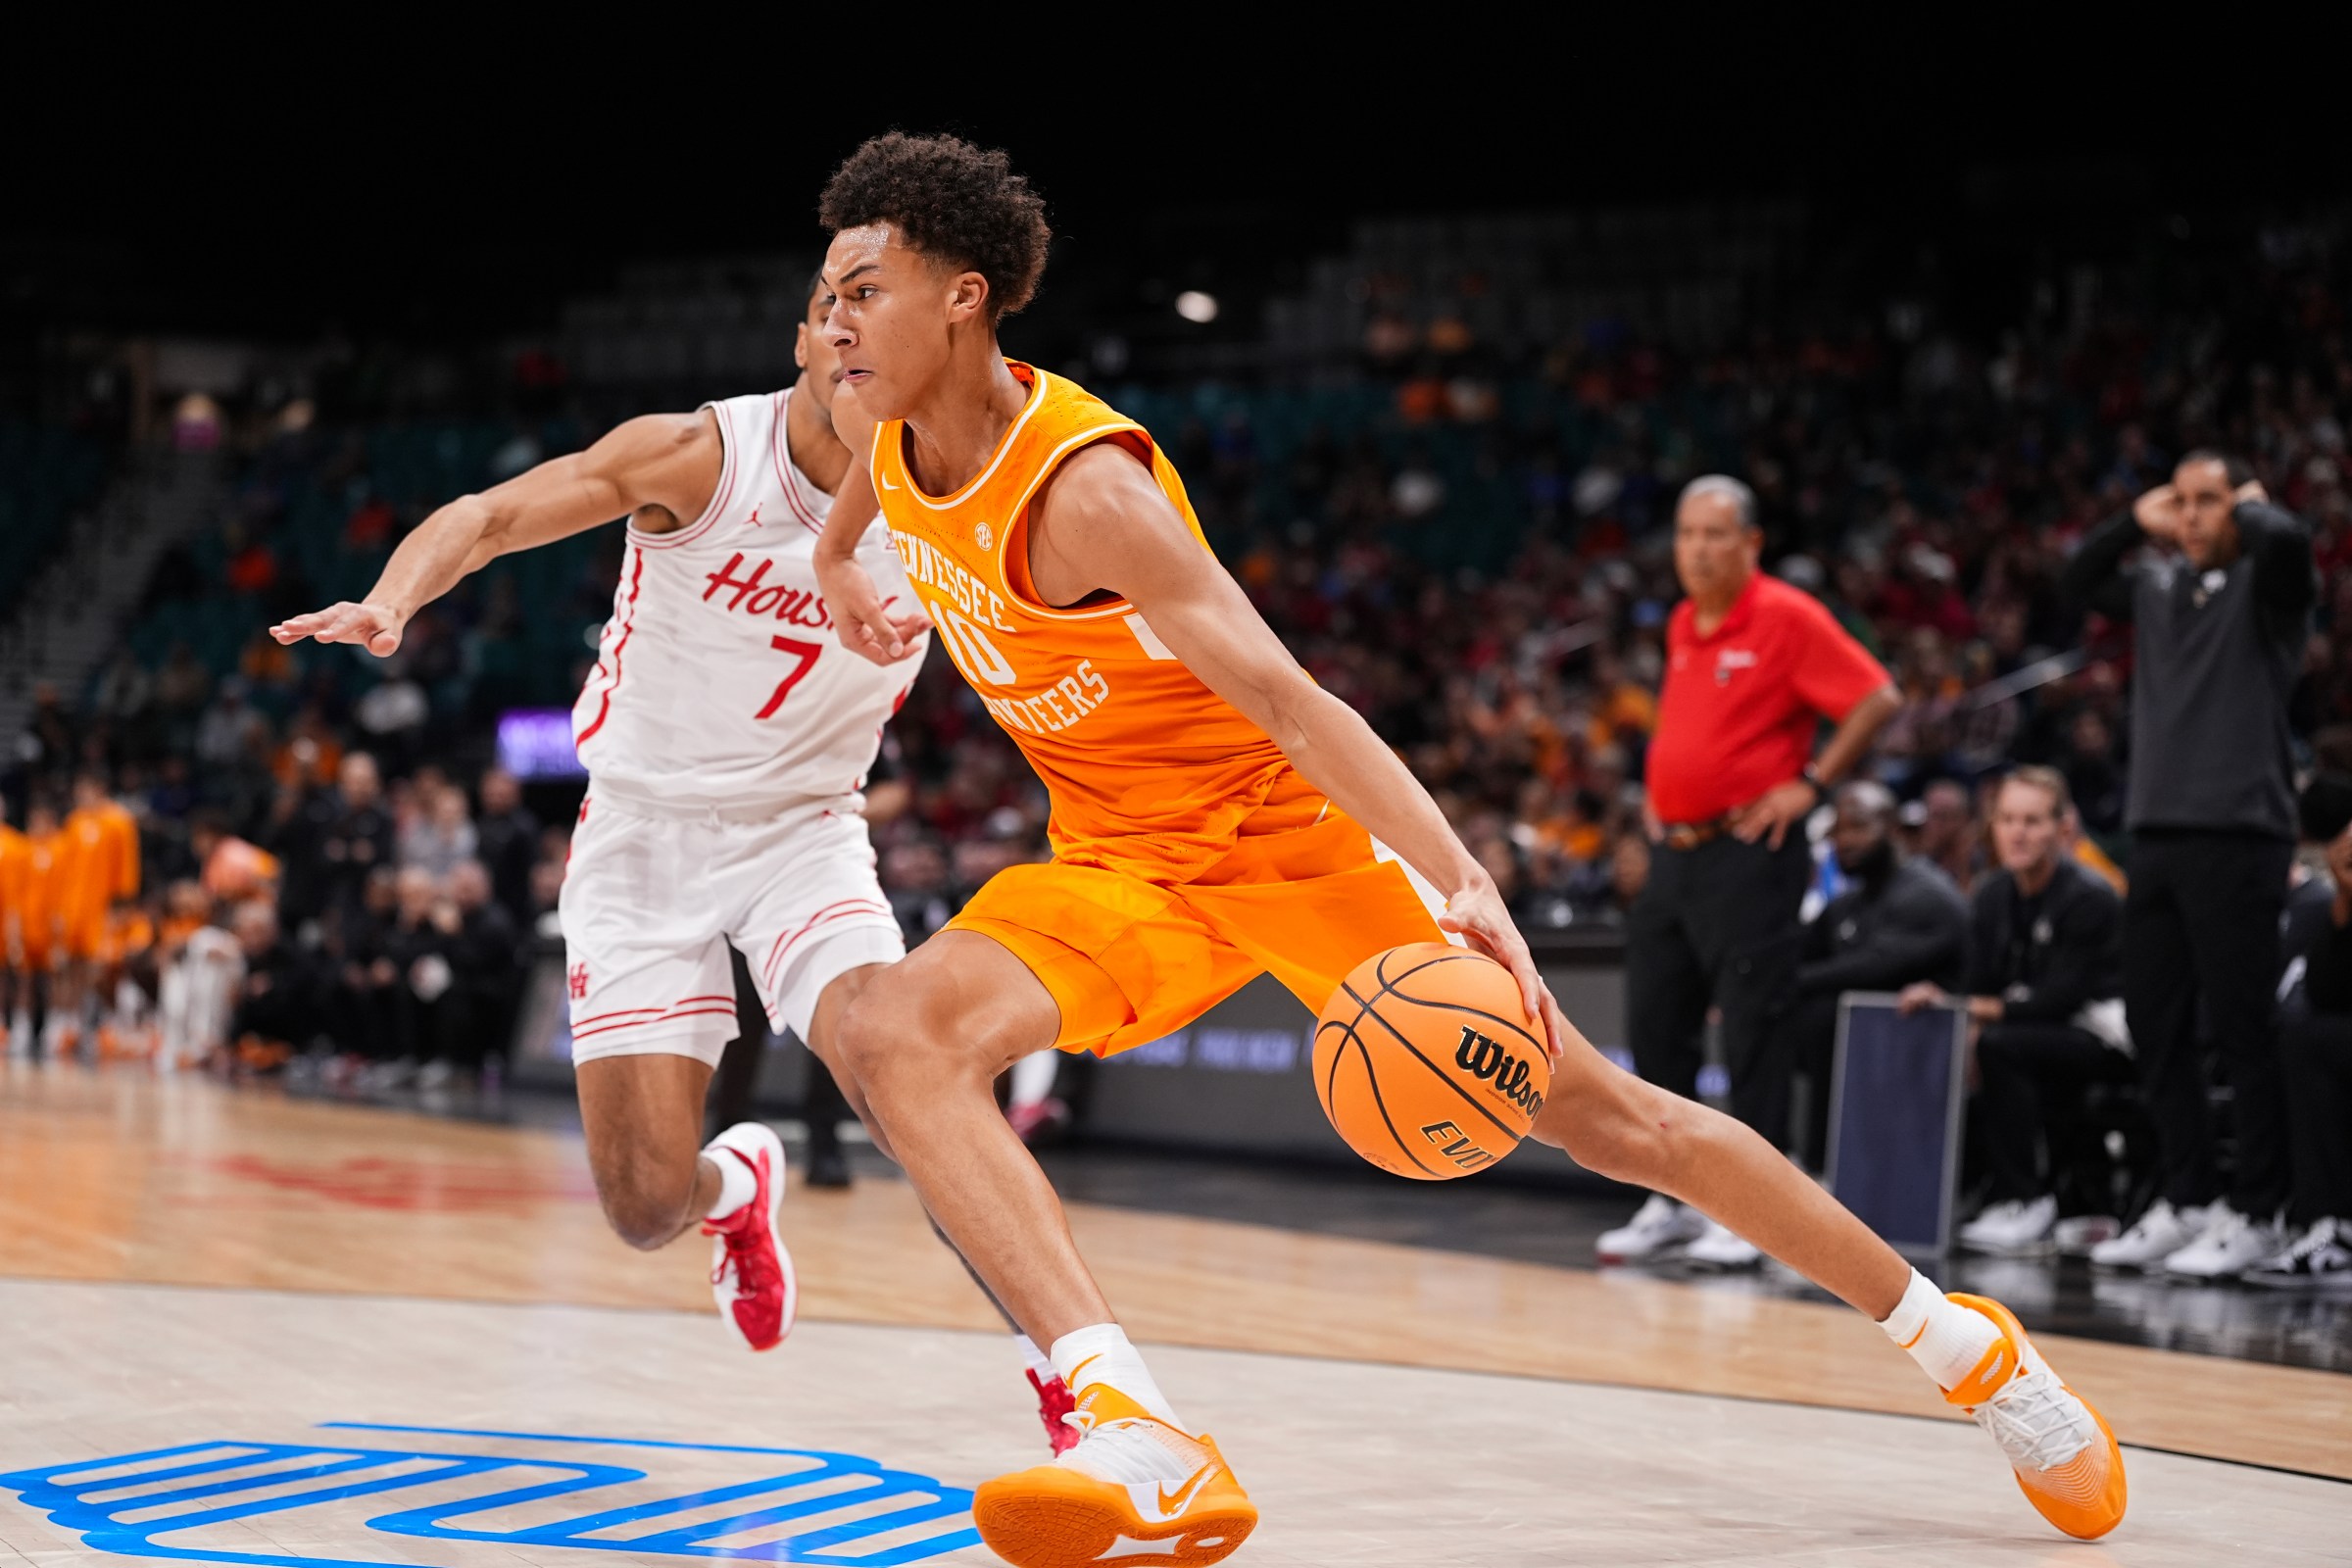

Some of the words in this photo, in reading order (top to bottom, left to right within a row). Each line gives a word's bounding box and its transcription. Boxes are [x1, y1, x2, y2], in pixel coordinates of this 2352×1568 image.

[976, 522, 992, 550] SEC
[702, 552, 899, 631] Hous
[754, 634, 823, 719] 7
[930, 600, 1017, 686] 10
[1420, 1120, 1494, 1169] EVO
